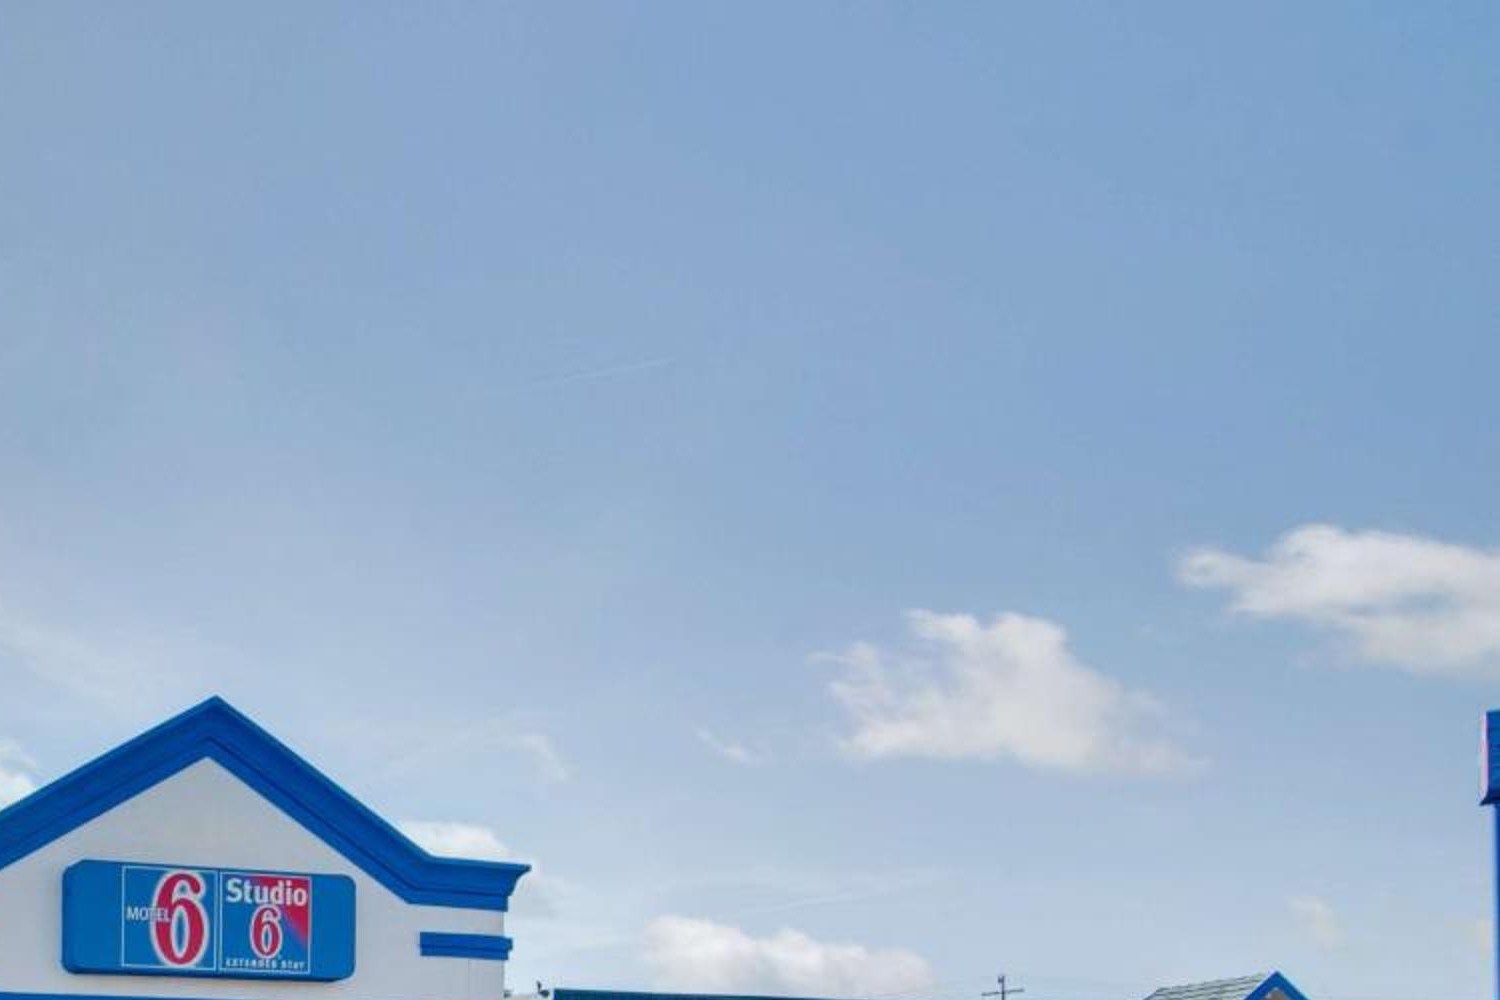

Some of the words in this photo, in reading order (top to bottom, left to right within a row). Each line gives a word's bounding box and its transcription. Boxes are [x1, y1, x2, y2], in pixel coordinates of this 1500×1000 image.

[226, 877, 308, 907] Studio
[125, 906, 171, 922] MOTEL
[152, 869, 209, 967] 6
[250, 903, 283, 959] 6
[225, 958, 277, 969] EXTENDED
[280, 960, 305, 970] STAY
